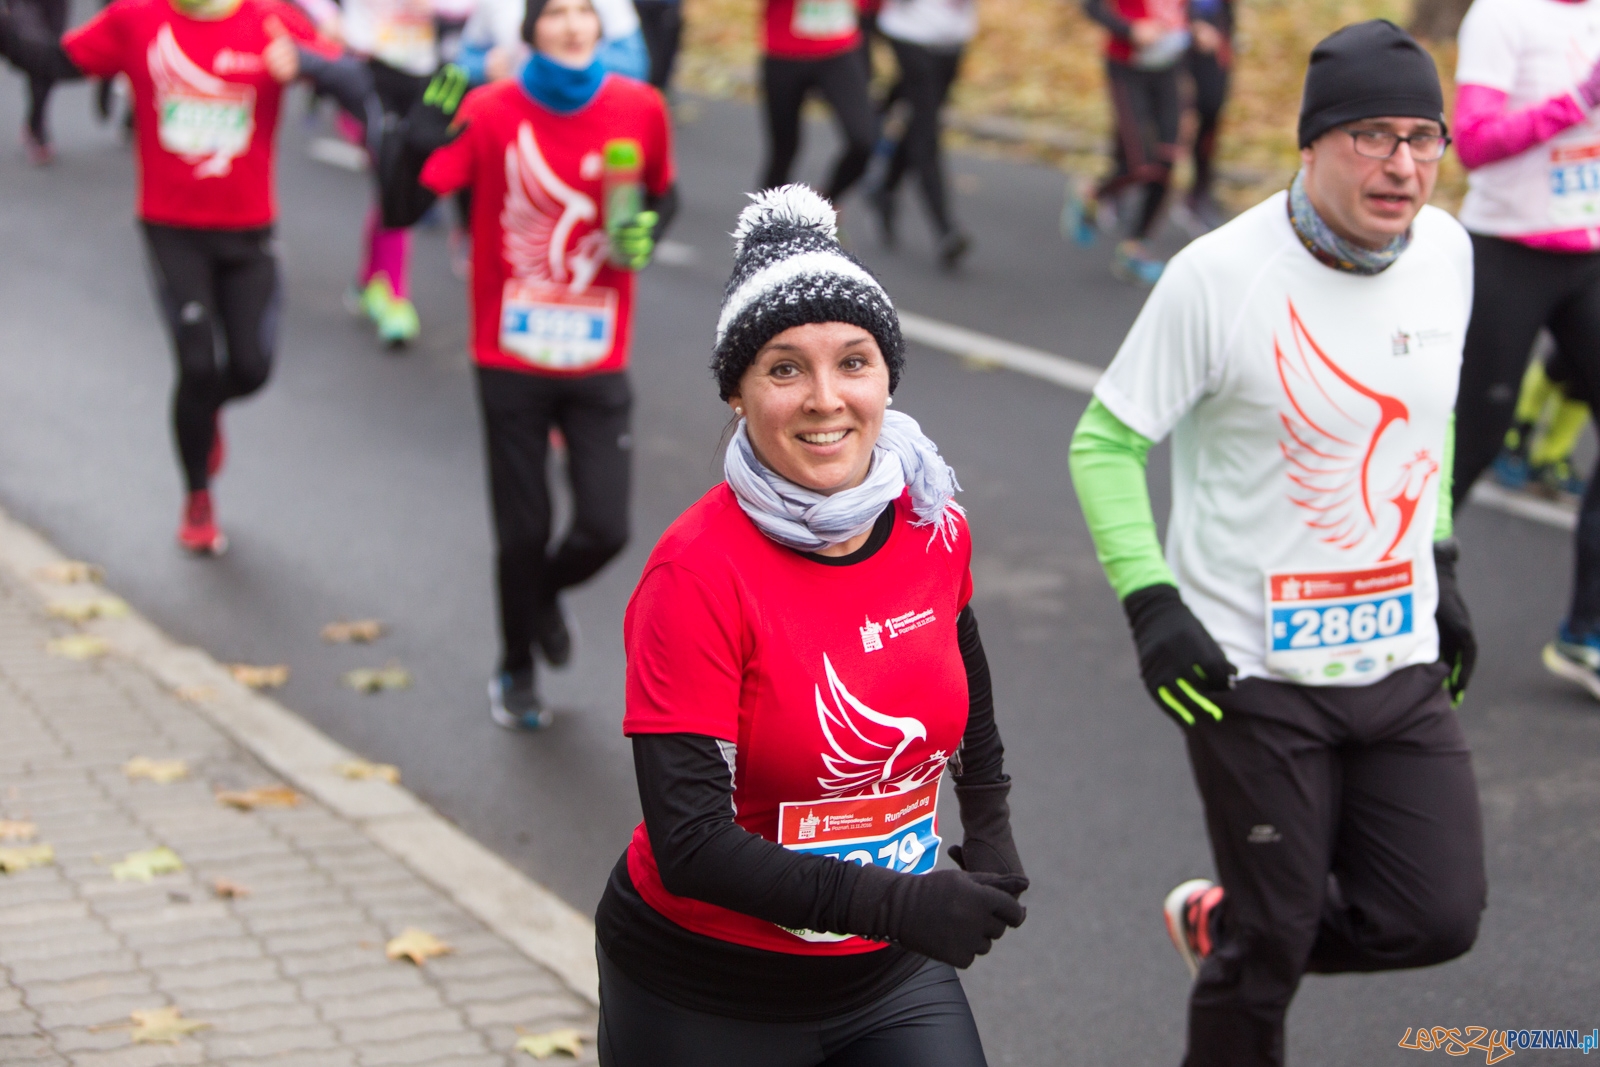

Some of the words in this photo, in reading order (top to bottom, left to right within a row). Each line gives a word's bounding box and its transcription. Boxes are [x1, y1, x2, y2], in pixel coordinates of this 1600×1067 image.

[884, 618, 899, 639] 1
[1289, 598, 1404, 649] 2860
[885, 795, 930, 823] RunPoland.org
[822, 815, 831, 832] 1
[824, 832, 926, 873] 79
